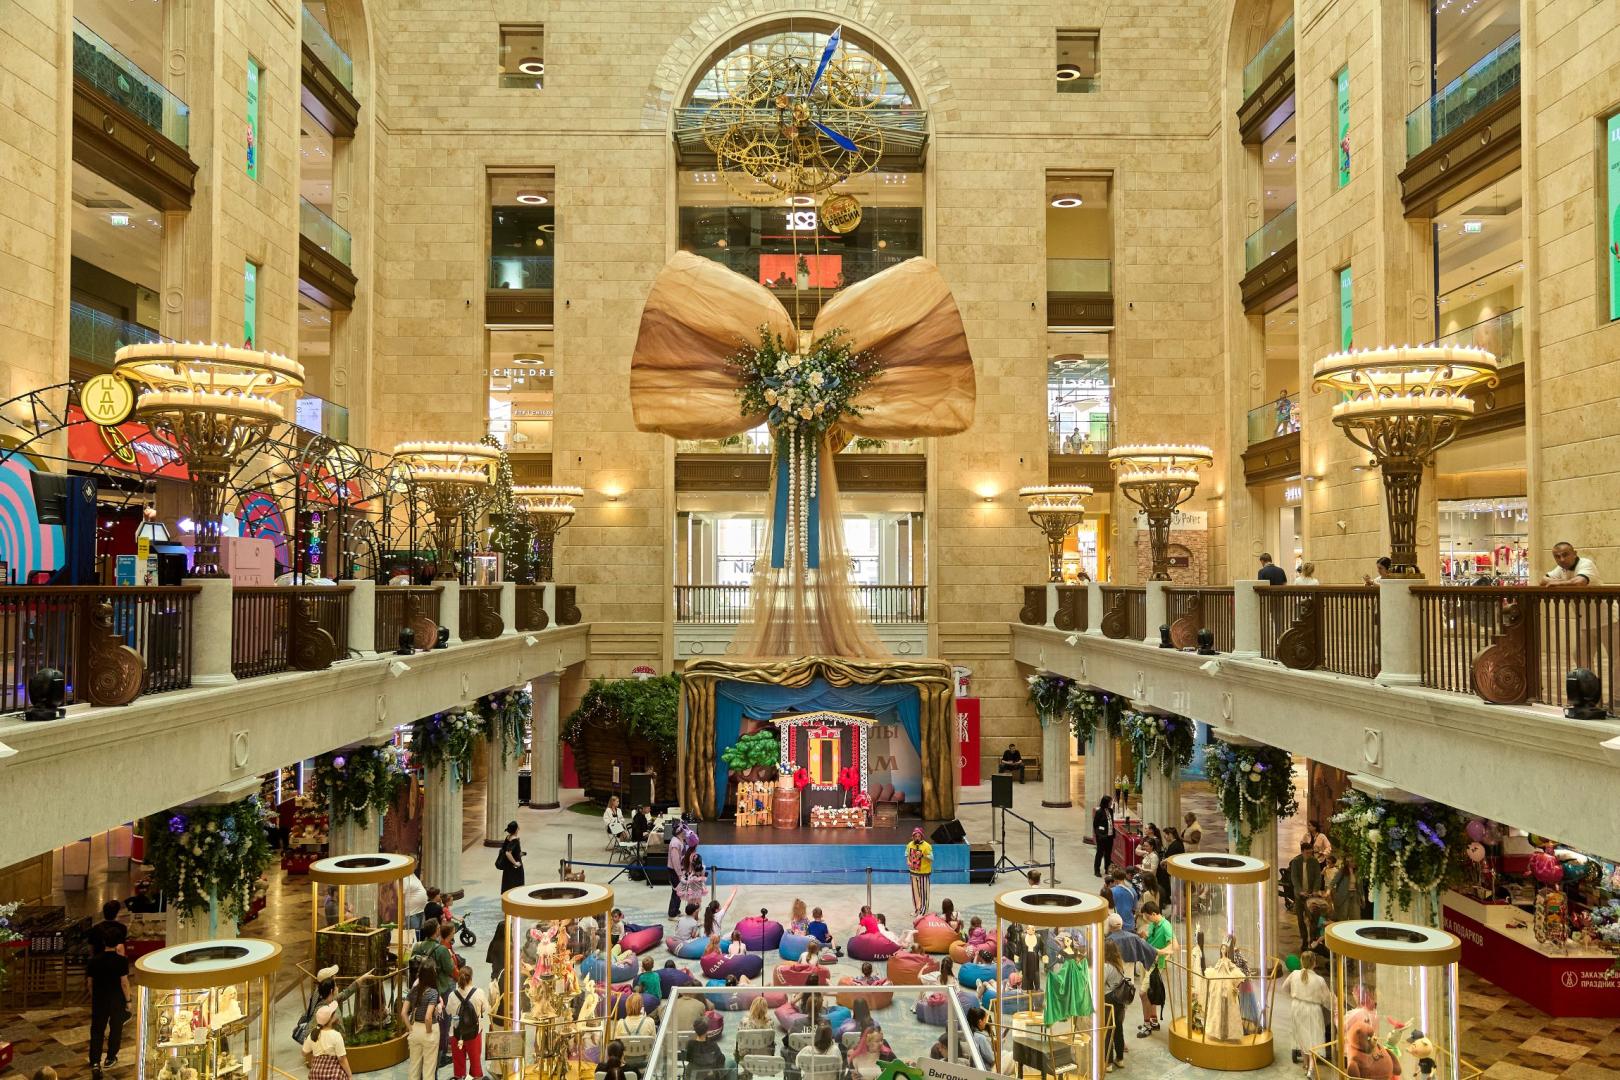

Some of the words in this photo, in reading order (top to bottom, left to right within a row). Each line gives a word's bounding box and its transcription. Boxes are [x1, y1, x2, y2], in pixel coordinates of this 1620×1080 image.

[828, 210, 860, 229] РОССИИ
[98, 378, 116, 416] ЦДМ
[868, 726, 898, 739] ЛЫ
[1453, 921, 1484, 947] ПОДАРКОВ
[1580, 980, 1615, 988] ПРАЗДНИК
[928, 1068, 968, 1080] Выгод
